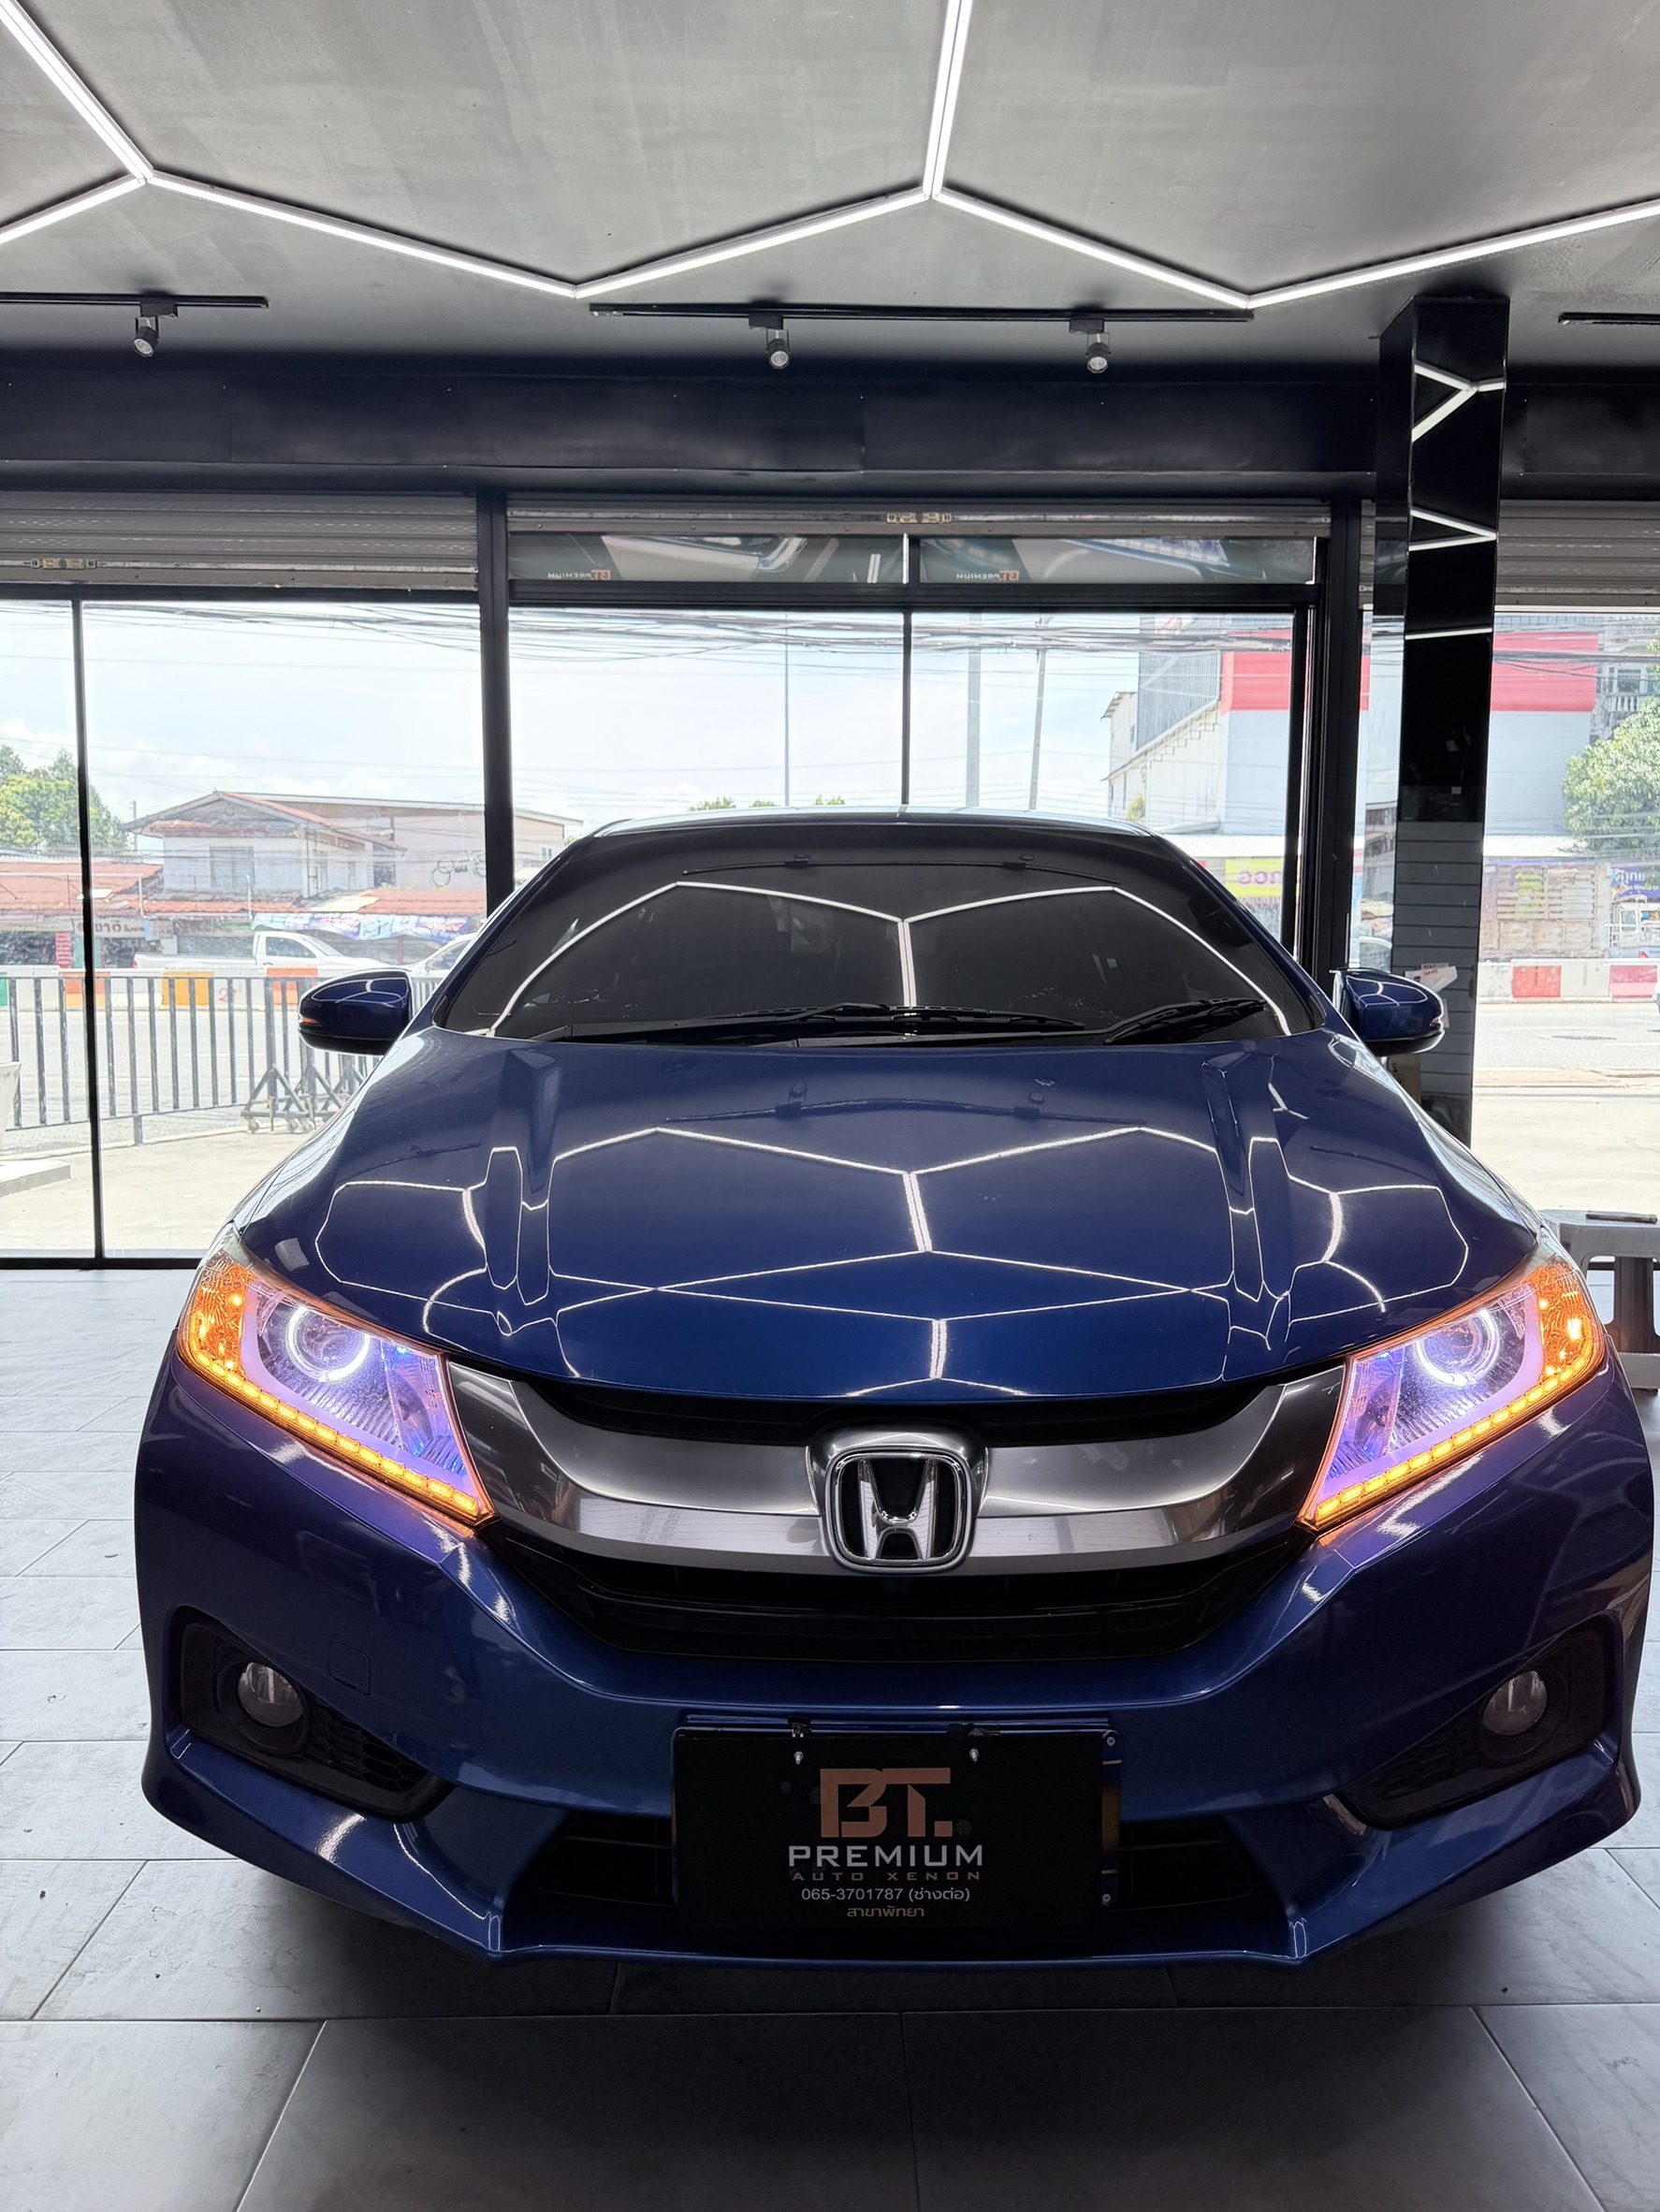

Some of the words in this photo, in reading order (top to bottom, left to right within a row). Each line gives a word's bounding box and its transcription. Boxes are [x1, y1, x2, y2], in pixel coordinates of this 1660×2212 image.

[788, 1844, 983, 1868] PREMIUM
[792, 1871, 864, 1882] AUTO
[887, 1871, 981, 1882] XENON
[801, 1887, 904, 1900] 065-3701787
[908, 1886, 970, 1902] (ช่างต่อ)
[846, 1904, 925, 1917] สาขาพัทยา
